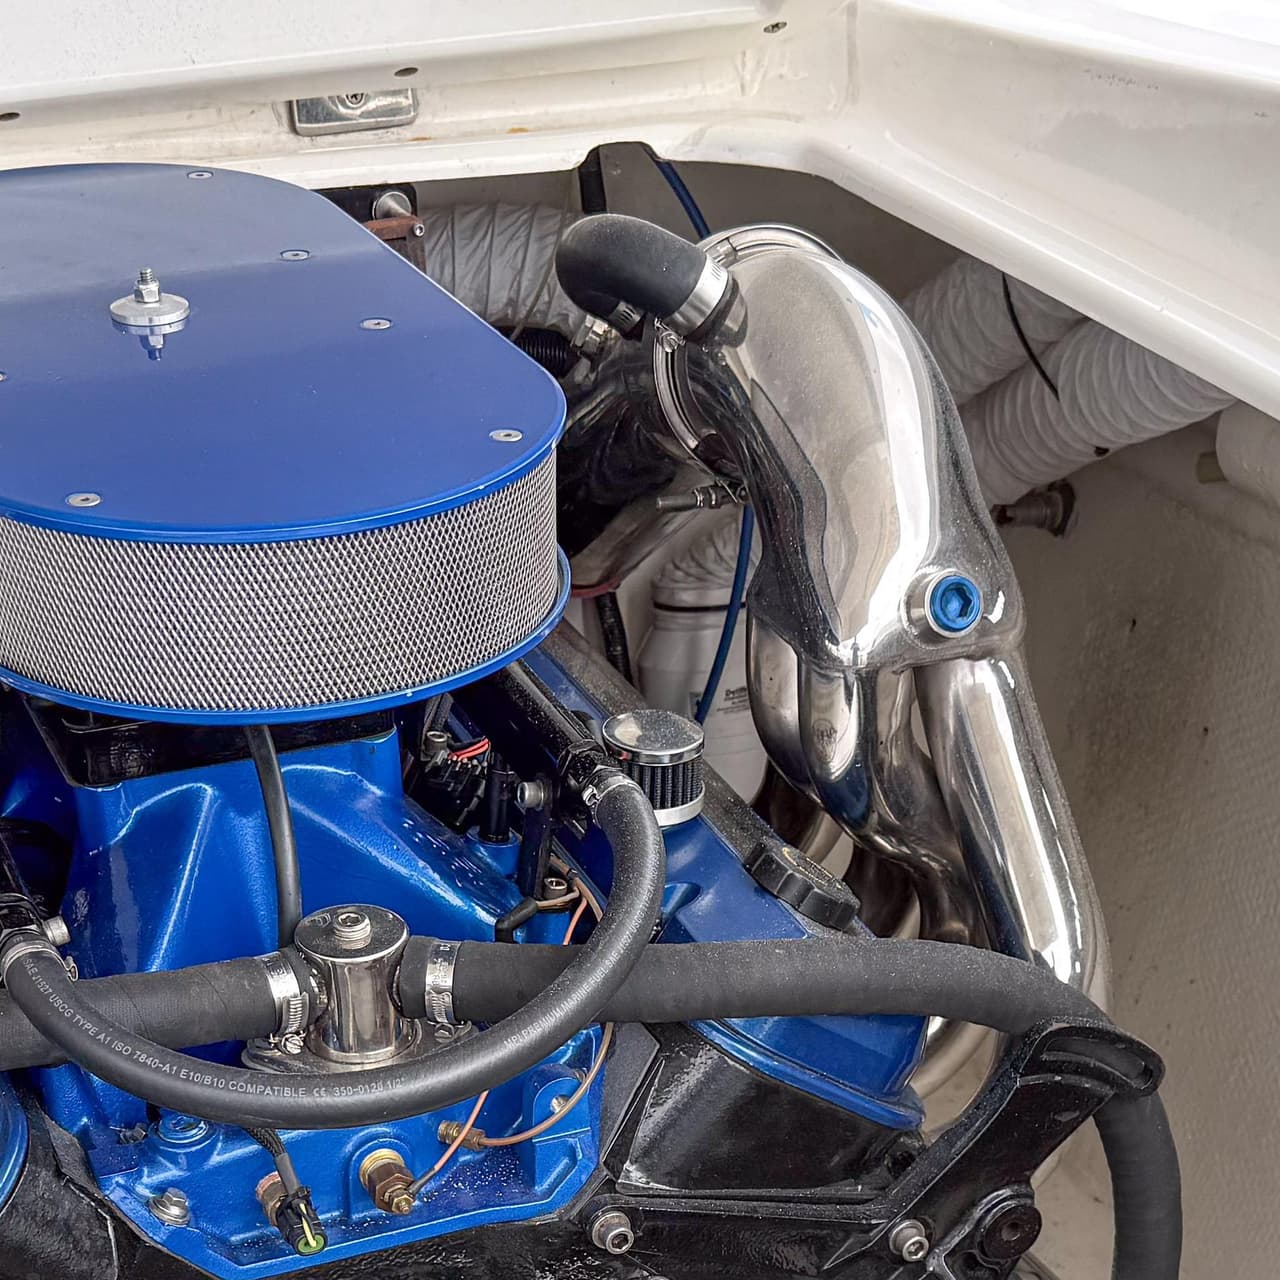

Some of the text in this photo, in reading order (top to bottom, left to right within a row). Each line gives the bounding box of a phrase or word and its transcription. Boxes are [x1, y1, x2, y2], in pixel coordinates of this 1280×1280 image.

[22, 957, 38, 976] SAE
[31, 972, 53, 995] J1527
[48, 993, 74, 1018] USCG
[72, 1014, 99, 1037] TYPE
[96, 1032, 111, 1045] A1
[111, 1040, 132, 1056] ISO
[133, 1050, 177, 1076] 7840-A1
[179, 1070, 225, 1089] E10/B10
[228, 1080, 307, 1098] COMPATIBLE
[561, 981, 591, 1014] MARINE
[588, 965, 609, 989] FUEL
